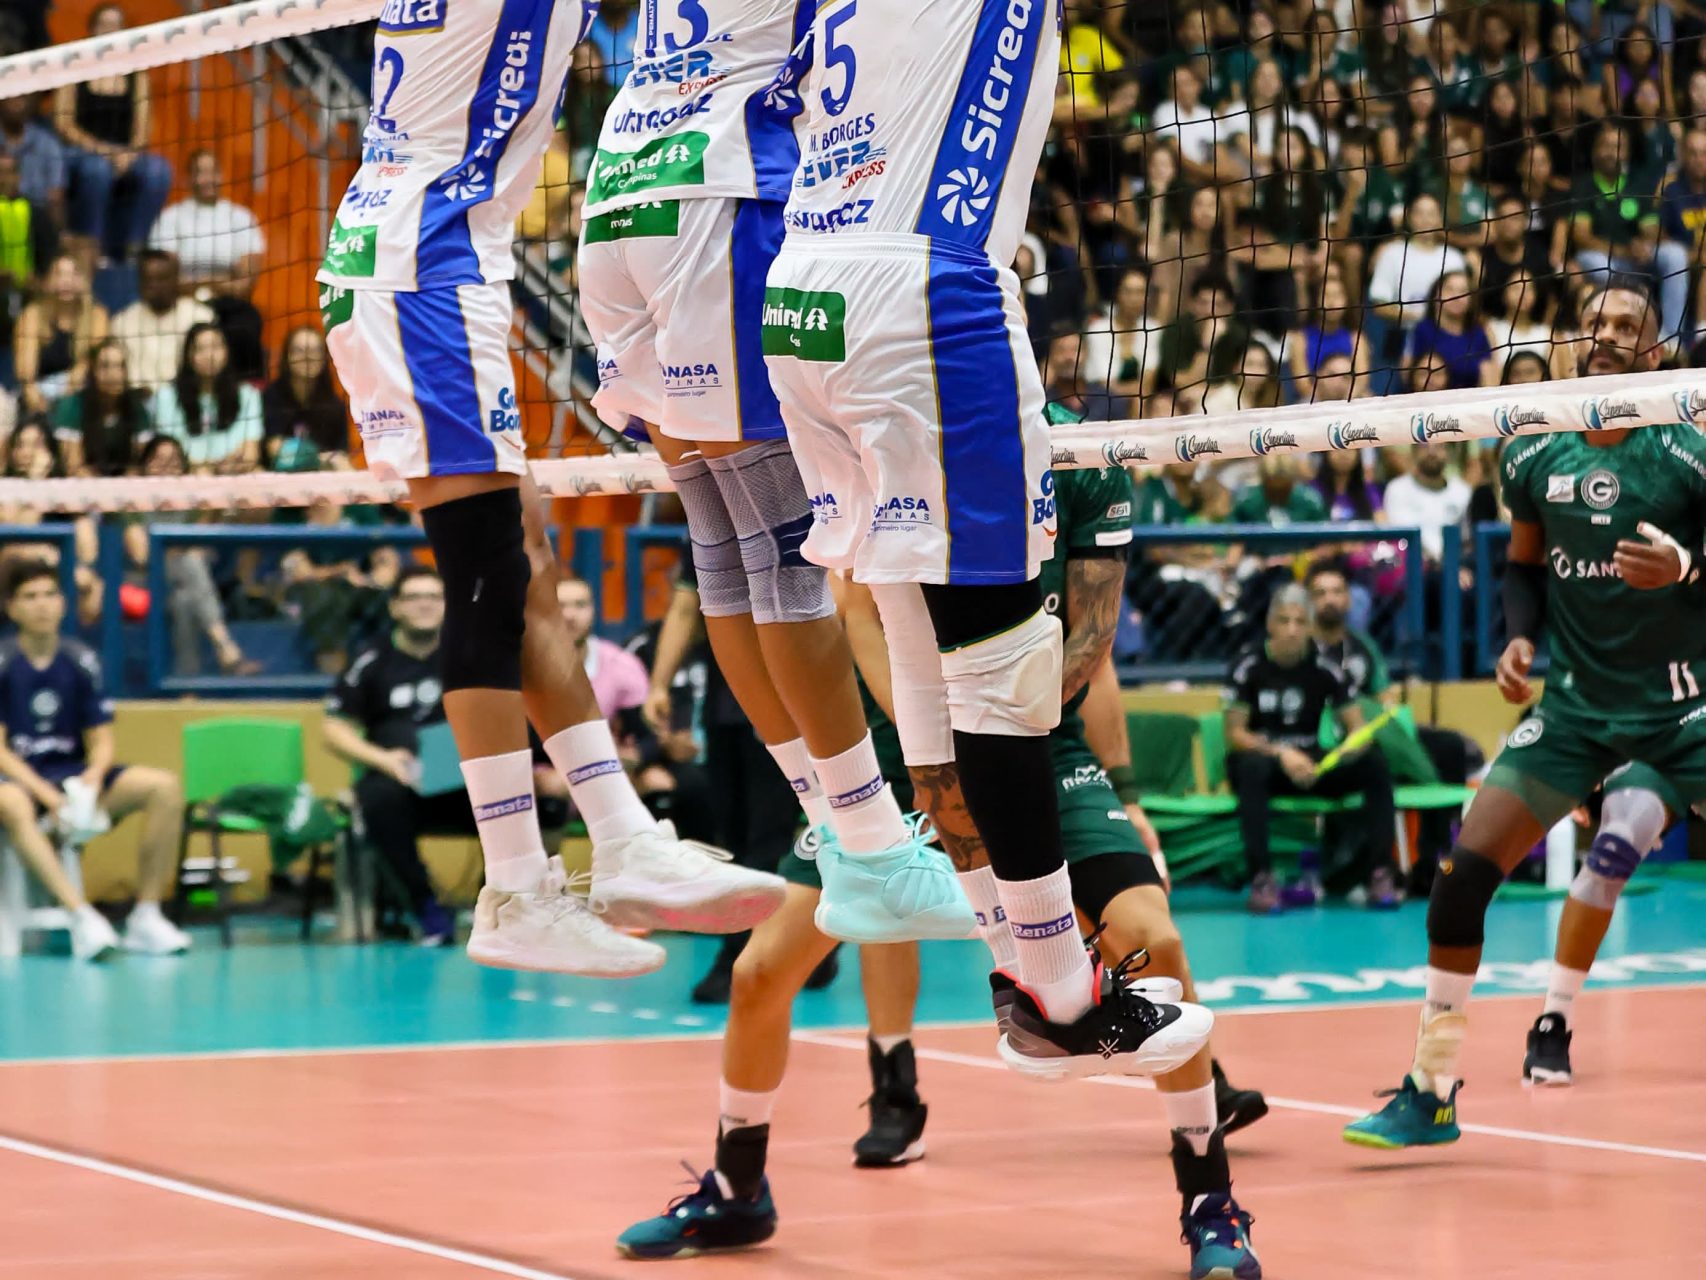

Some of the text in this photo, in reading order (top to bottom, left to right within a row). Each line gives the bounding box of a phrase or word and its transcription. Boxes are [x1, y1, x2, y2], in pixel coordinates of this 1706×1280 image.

[371, 46, 405, 134] 2
[821, 112, 876, 151] BORGES
[658, 362, 719, 379] NASA
[664, 377, 719, 387] PINAS
[1576, 560, 1622, 578] SAN
[1668, 661, 1700, 702] 11
[830, 776, 884, 808] Renata
[1012, 917, 1073, 940] Renata
